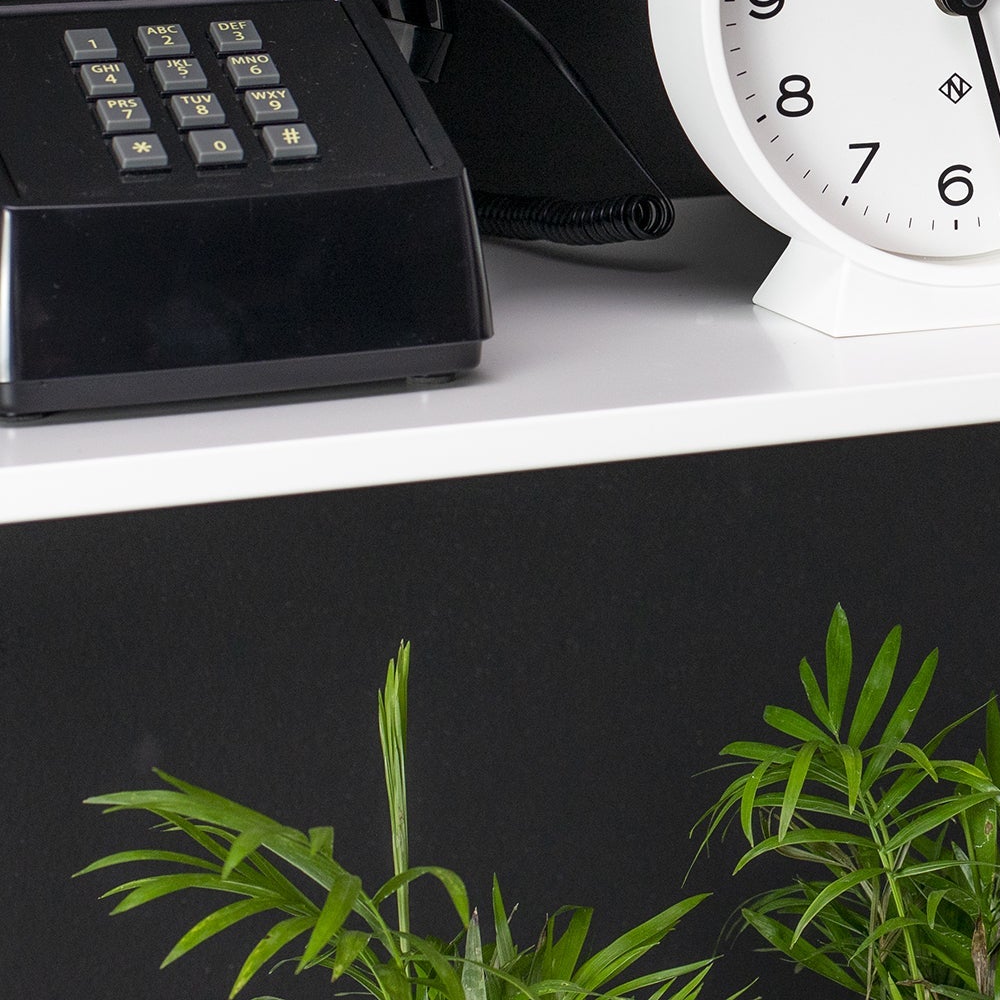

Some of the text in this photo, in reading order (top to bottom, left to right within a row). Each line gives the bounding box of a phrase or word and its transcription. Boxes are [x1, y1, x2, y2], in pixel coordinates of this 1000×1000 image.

[147, 24, 178, 35] ABC
[218, 21, 247, 31] DEF
[162, 34, 174, 46] 2
[233, 30, 245, 41] 3
[88, 39, 98, 49] 1
[167, 58, 192, 68] JKL
[231, 54, 269, 65] MNO
[91, 63, 120, 73] GHI
[178, 66, 189, 76] 5
[249, 64, 262, 75] 6
[105, 73, 117, 84] 4
[180, 94, 212, 104] TUV
[251, 89, 286, 100] WXY
[776, 74, 814, 118] 8
[107, 99, 138, 109] PRS
[268, 99, 282, 111] 9
[121, 108, 133, 120] 7
[196, 104, 209, 116] 8
[213, 140, 227, 152] 0
[848, 141, 881, 184] 7
[937, 164, 974, 207] 6
